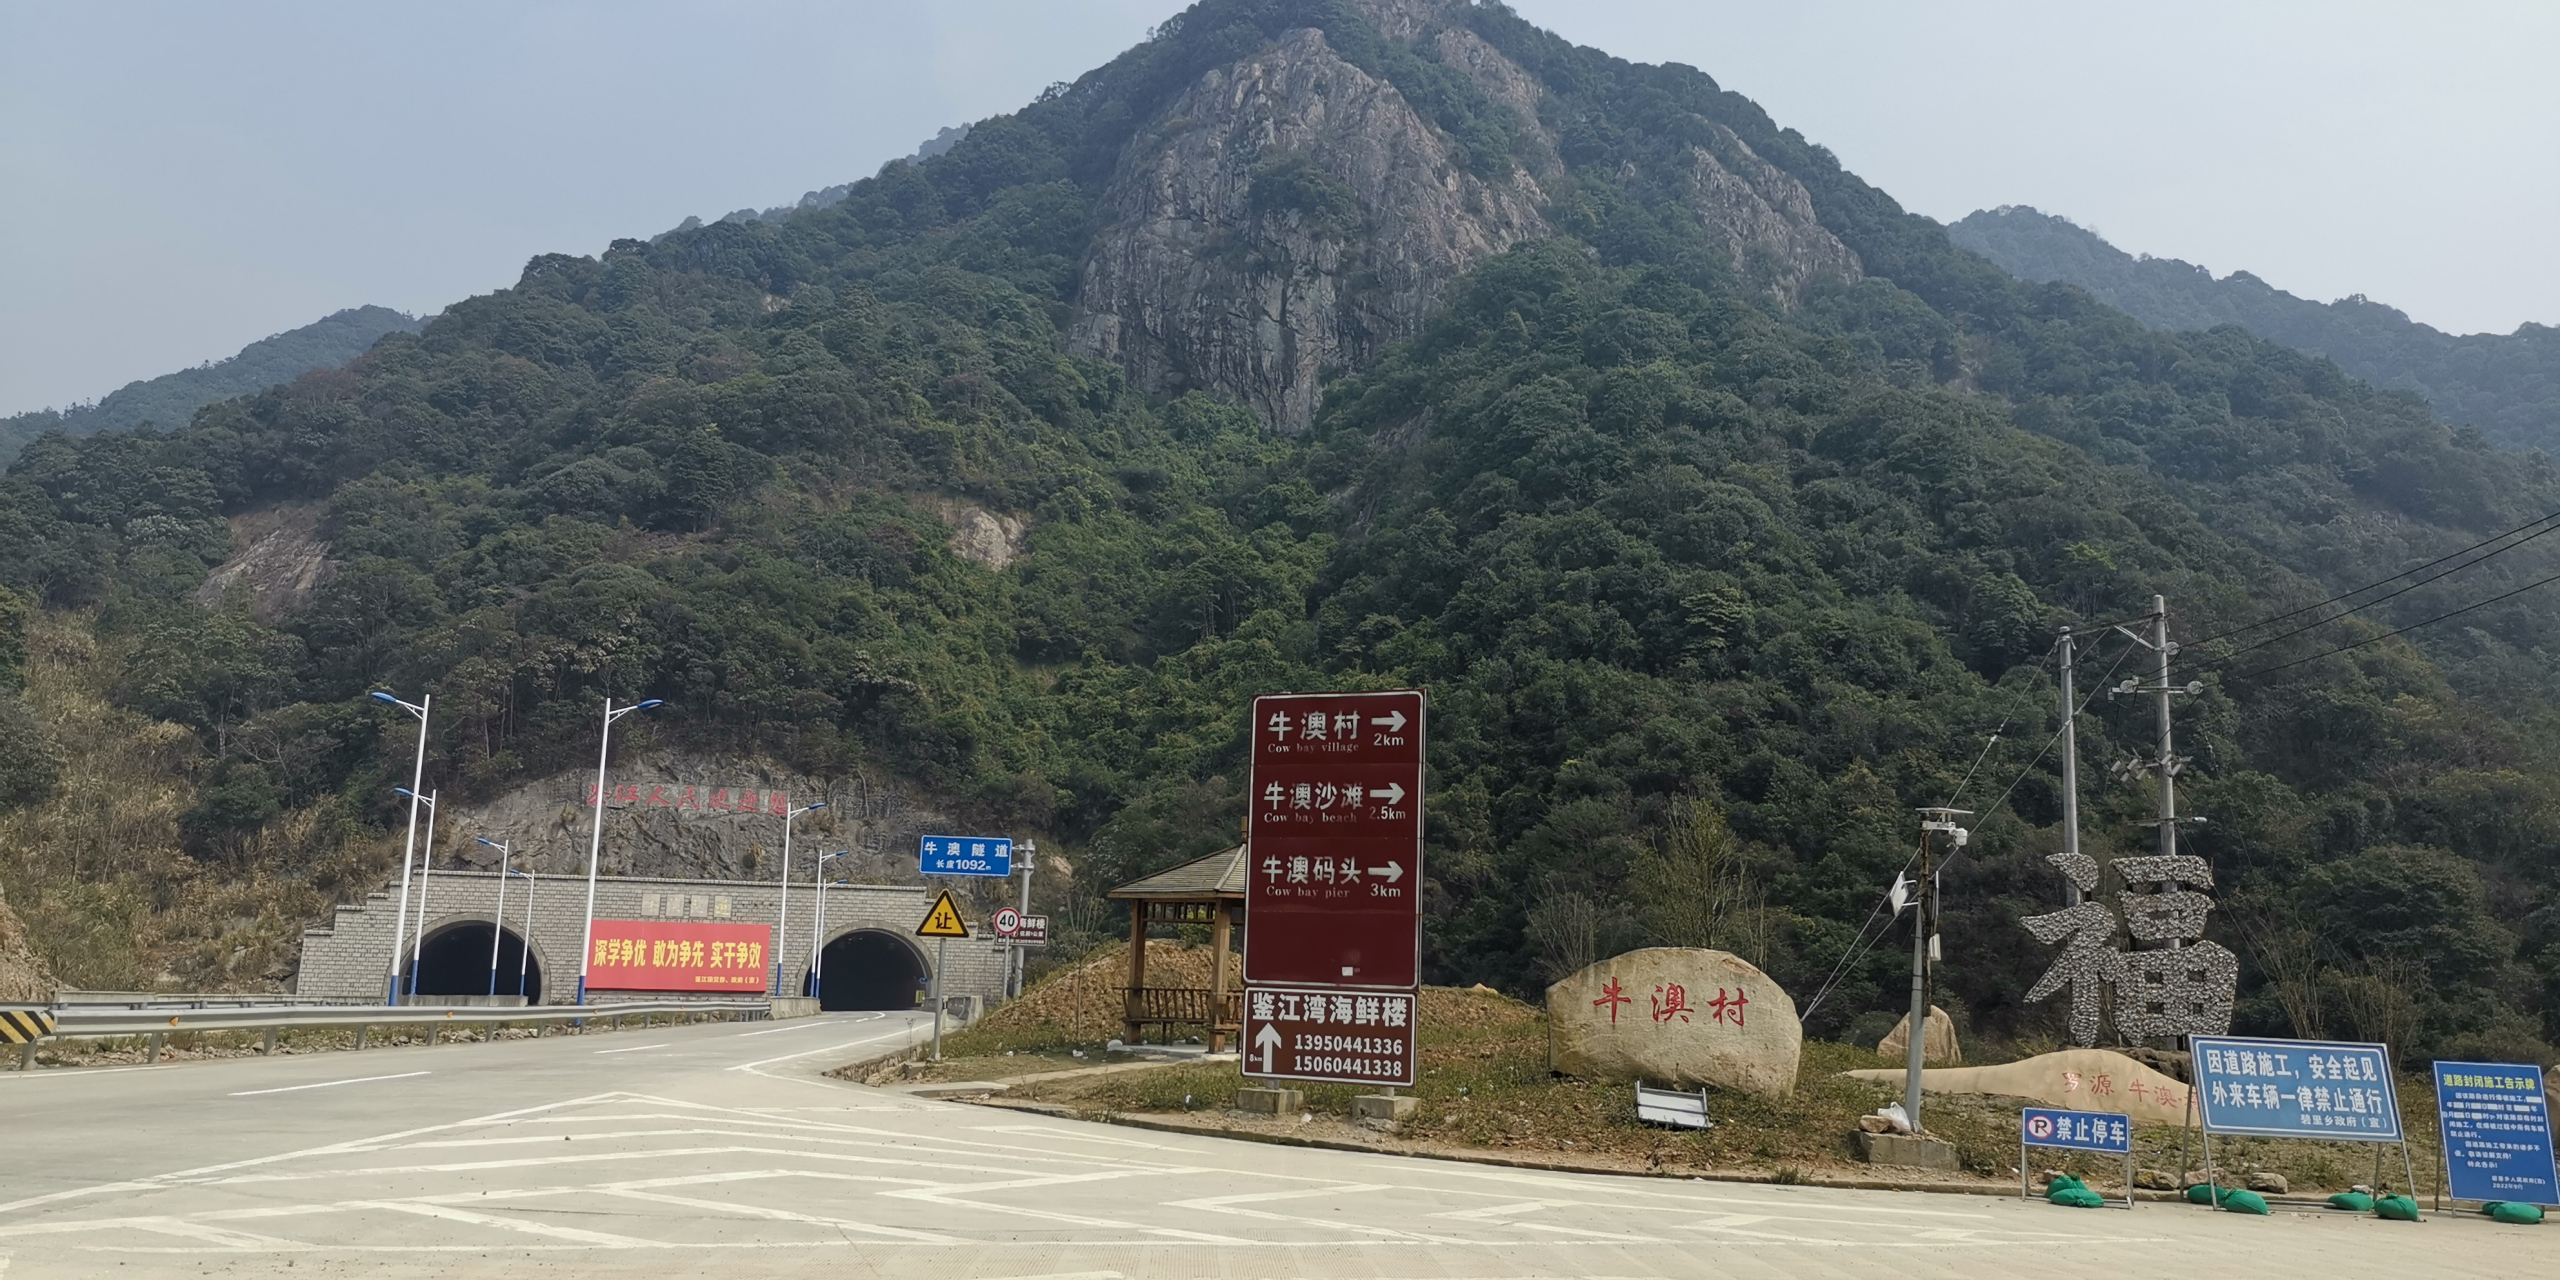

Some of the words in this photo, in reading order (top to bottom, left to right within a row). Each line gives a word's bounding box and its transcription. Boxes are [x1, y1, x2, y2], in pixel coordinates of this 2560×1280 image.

[1268, 710, 1360, 741] 牛澳村
[1268, 743, 1291, 753] Cow
[1297, 742, 1316, 754] bay
[1321, 742, 1359, 753] village
[1373, 732, 1404, 746] 2km
[1263, 780, 1363, 810] 牛澳沙滩
[1263, 812, 1288, 823] Cow
[1295, 812, 1314, 824] bay
[1322, 812, 1357, 823] beach
[1369, 806, 1406, 820] 2.5km
[924, 841, 1008, 857] 牛澳隧道
[1261, 854, 1362, 884] 牛澳码头
[1266, 886, 1292, 896] Cow
[1298, 886, 1319, 899] bay
[1325, 887, 1350, 899] pier
[1370, 883, 1401, 897] 3km
[934, 912, 952, 930] 让
[999, 914, 1015, 927] 40
[593, 939, 647, 967] 深学争优
[652, 939, 705, 968] 敢为争先
[710, 941, 762, 969] 实干争效
[2020, 852, 2239, 1049] 福
[1252, 992, 1407, 1027] 鉴江湾海鲜楼
[1593, 976, 1749, 1027] 牛澳村
[1294, 1034, 1403, 1055] 13950441336
[1249, 1053, 1263, 1063] 8km
[1294, 1055, 1403, 1077] 15060441338
[2062, 1072, 2115, 1096] 罗源
[2443, 1073, 2536, 1090] 道路封闭施工告示牌
[2212, 1080, 2383, 1115] 外来车辆一律禁止通行
[2056, 1116, 2126, 1146] 禁止停车
